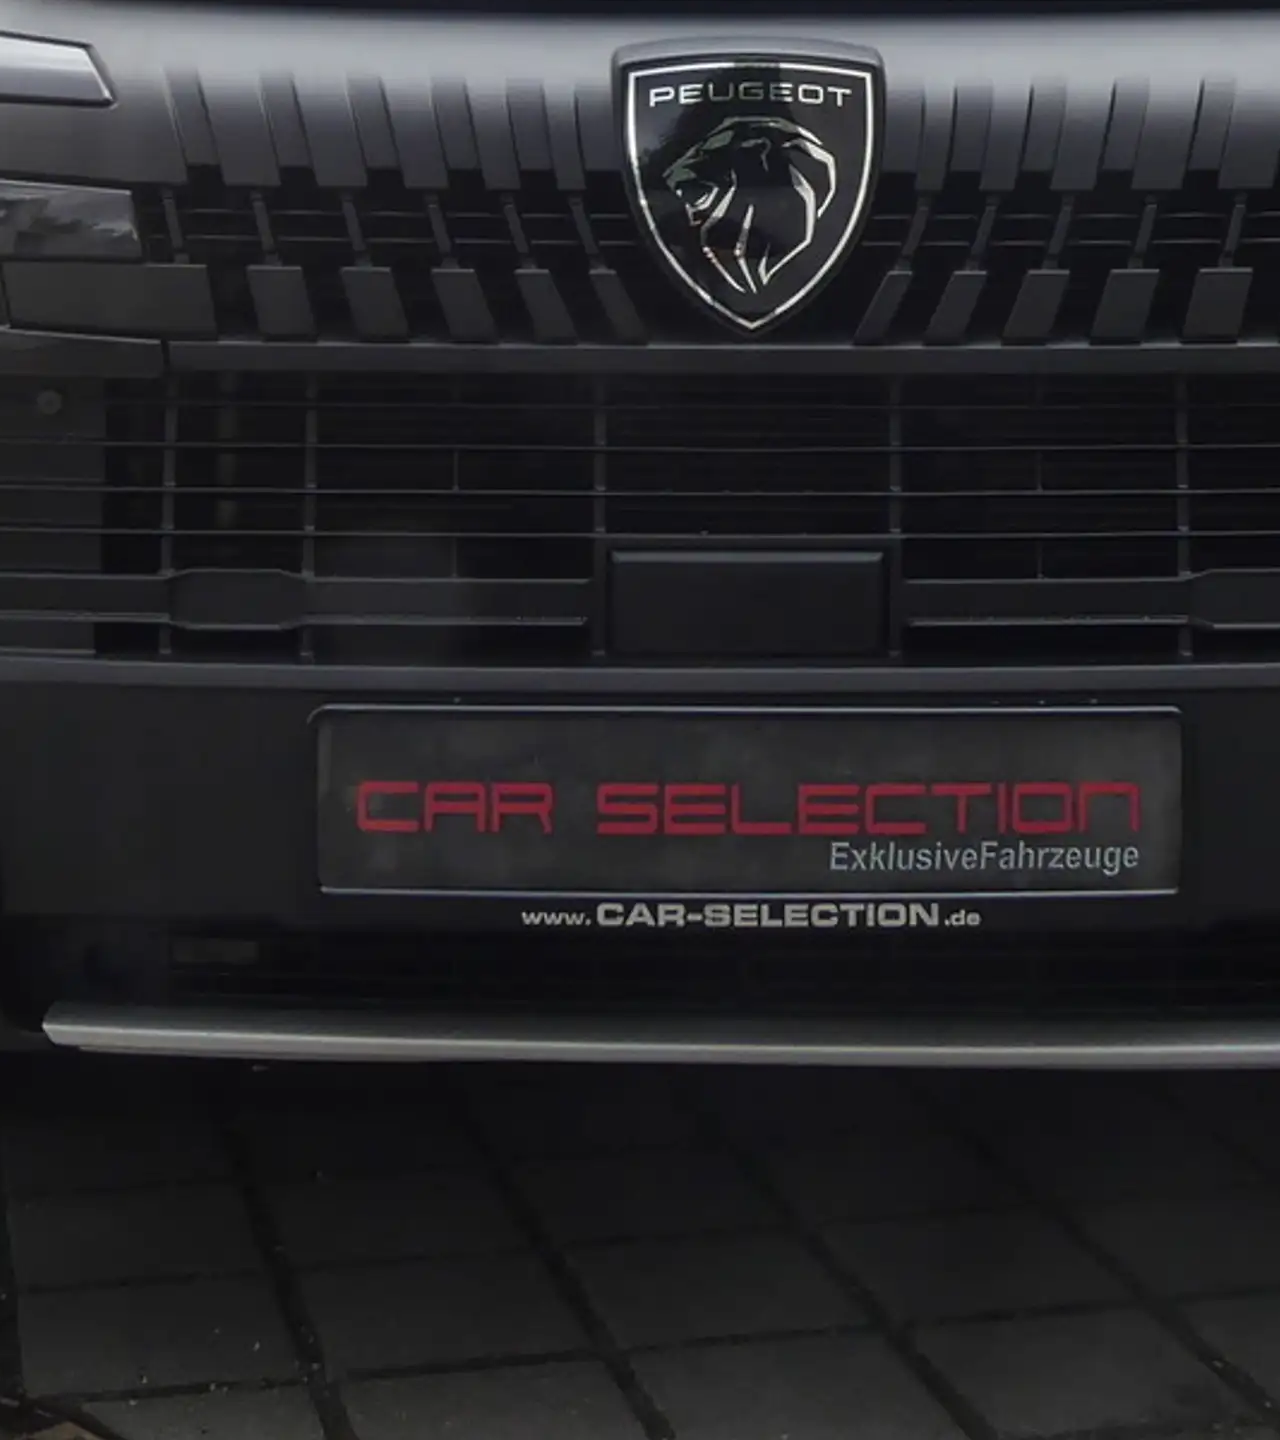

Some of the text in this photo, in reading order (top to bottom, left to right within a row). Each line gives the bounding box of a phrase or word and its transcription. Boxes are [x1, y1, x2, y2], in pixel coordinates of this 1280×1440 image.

[648, 81, 852, 107] PEUGEOT
[356, 781, 1141, 836] CAR SELECTION
[829, 841, 1139, 876] ExklusiveFahrzeuge
